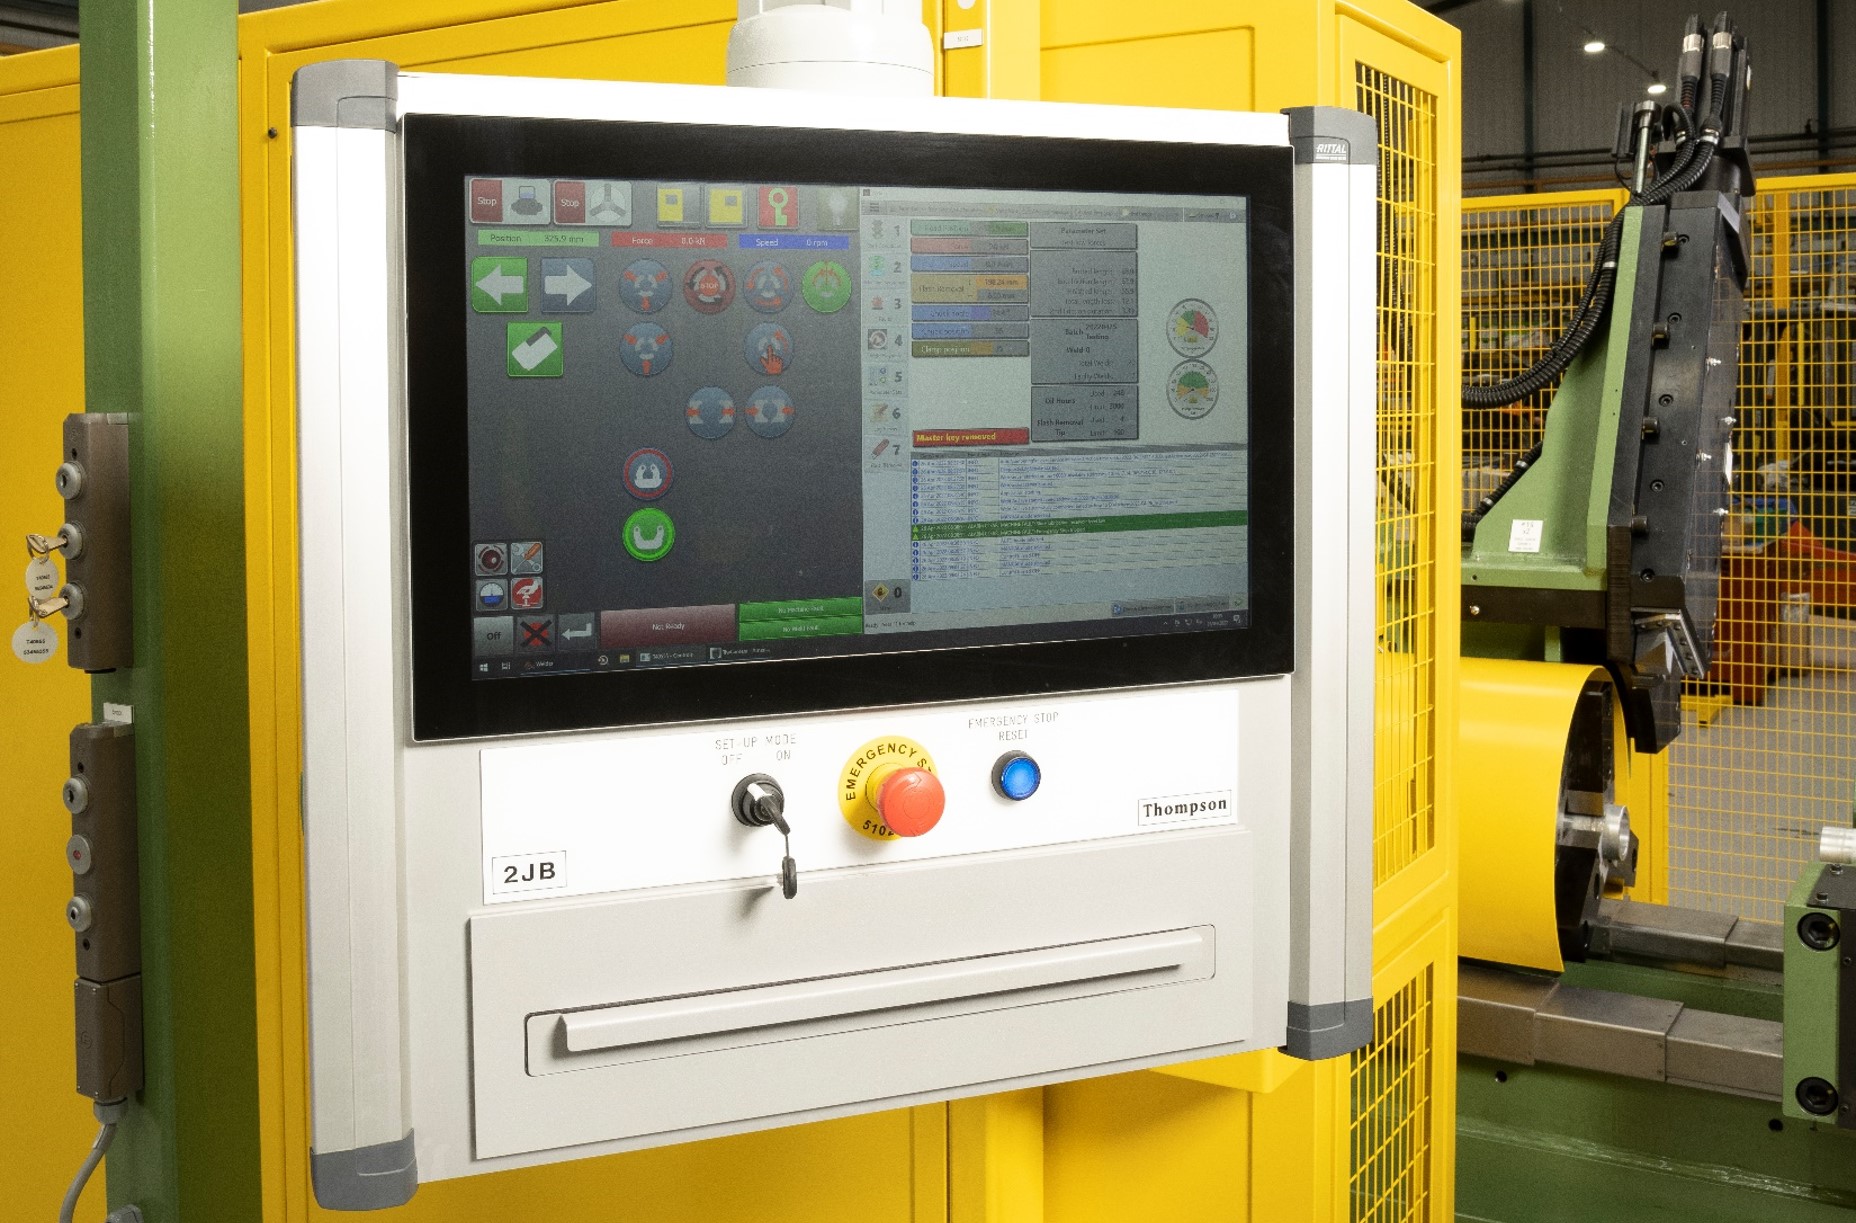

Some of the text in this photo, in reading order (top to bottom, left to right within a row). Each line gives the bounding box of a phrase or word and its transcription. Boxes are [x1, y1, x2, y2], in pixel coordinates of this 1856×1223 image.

[1316, 143, 1347, 154] RITTAL
[477, 196, 498, 207] Stop
[560, 198, 580, 209] Stop
[490, 234, 522, 243] Position
[631, 236, 654, 246] Force
[755, 238, 779, 249] Speed
[813, 239, 829, 249] rpm
[893, 260, 902, 274] 2
[894, 298, 902, 310] 3
[894, 334, 903, 346] 4
[894, 371, 903, 383] 5
[891, 407, 902, 420] 6
[916, 432, 997, 443] Master key removed
[892, 443, 901, 456] 7
[893, 586, 903, 599] 0
[652, 620, 685, 632] Not Ready
[486, 631, 502, 641] Off
[968, 711, 1059, 729] EMERGENCY STOP
[998, 729, 1028, 741] RESET
[714, 733, 797, 750] SET-UP MODE
[721, 749, 791, 766] OFF ON
[846, 743, 932, 801] EMERGENCY S
[1142, 798, 1228, 818] Thompson
[503, 861, 556, 884] 2JB
